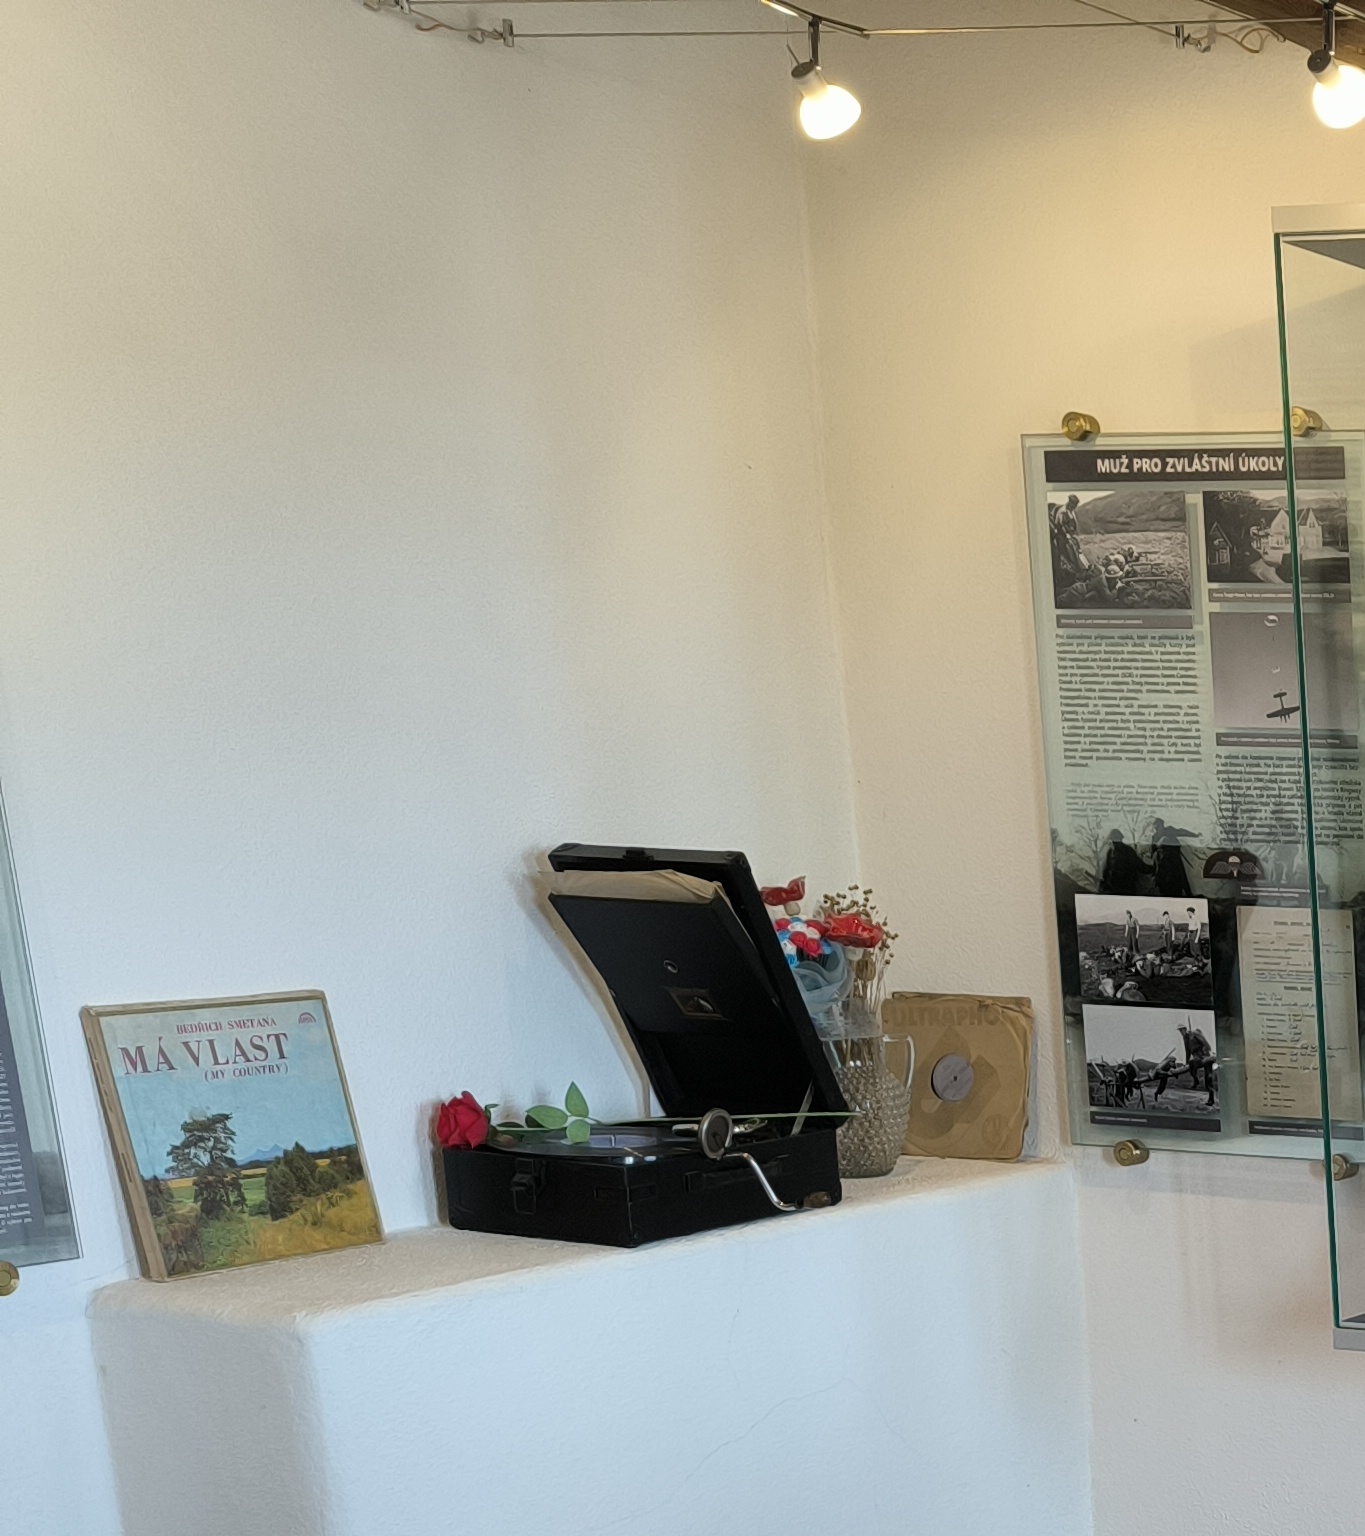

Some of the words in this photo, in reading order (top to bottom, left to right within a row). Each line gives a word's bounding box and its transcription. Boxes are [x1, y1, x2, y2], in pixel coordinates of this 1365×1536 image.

[1097, 453, 1129, 473] MUŽ
[1133, 456, 1161, 473] PRO
[1165, 452, 1234, 473] ZVLÁŠTNÍ
[1239, 451, 1284, 472] ÚKOLY
[176, 1020, 223, 1035] BEDŘICH
[227, 1015, 278, 1031] SMETANA
[118, 1037, 176, 1076] MÁ
[181, 1032, 290, 1070] VLAST
[204, 1069, 226, 1083] (MY
[232, 1063, 289, 1079] COUNTRY)
